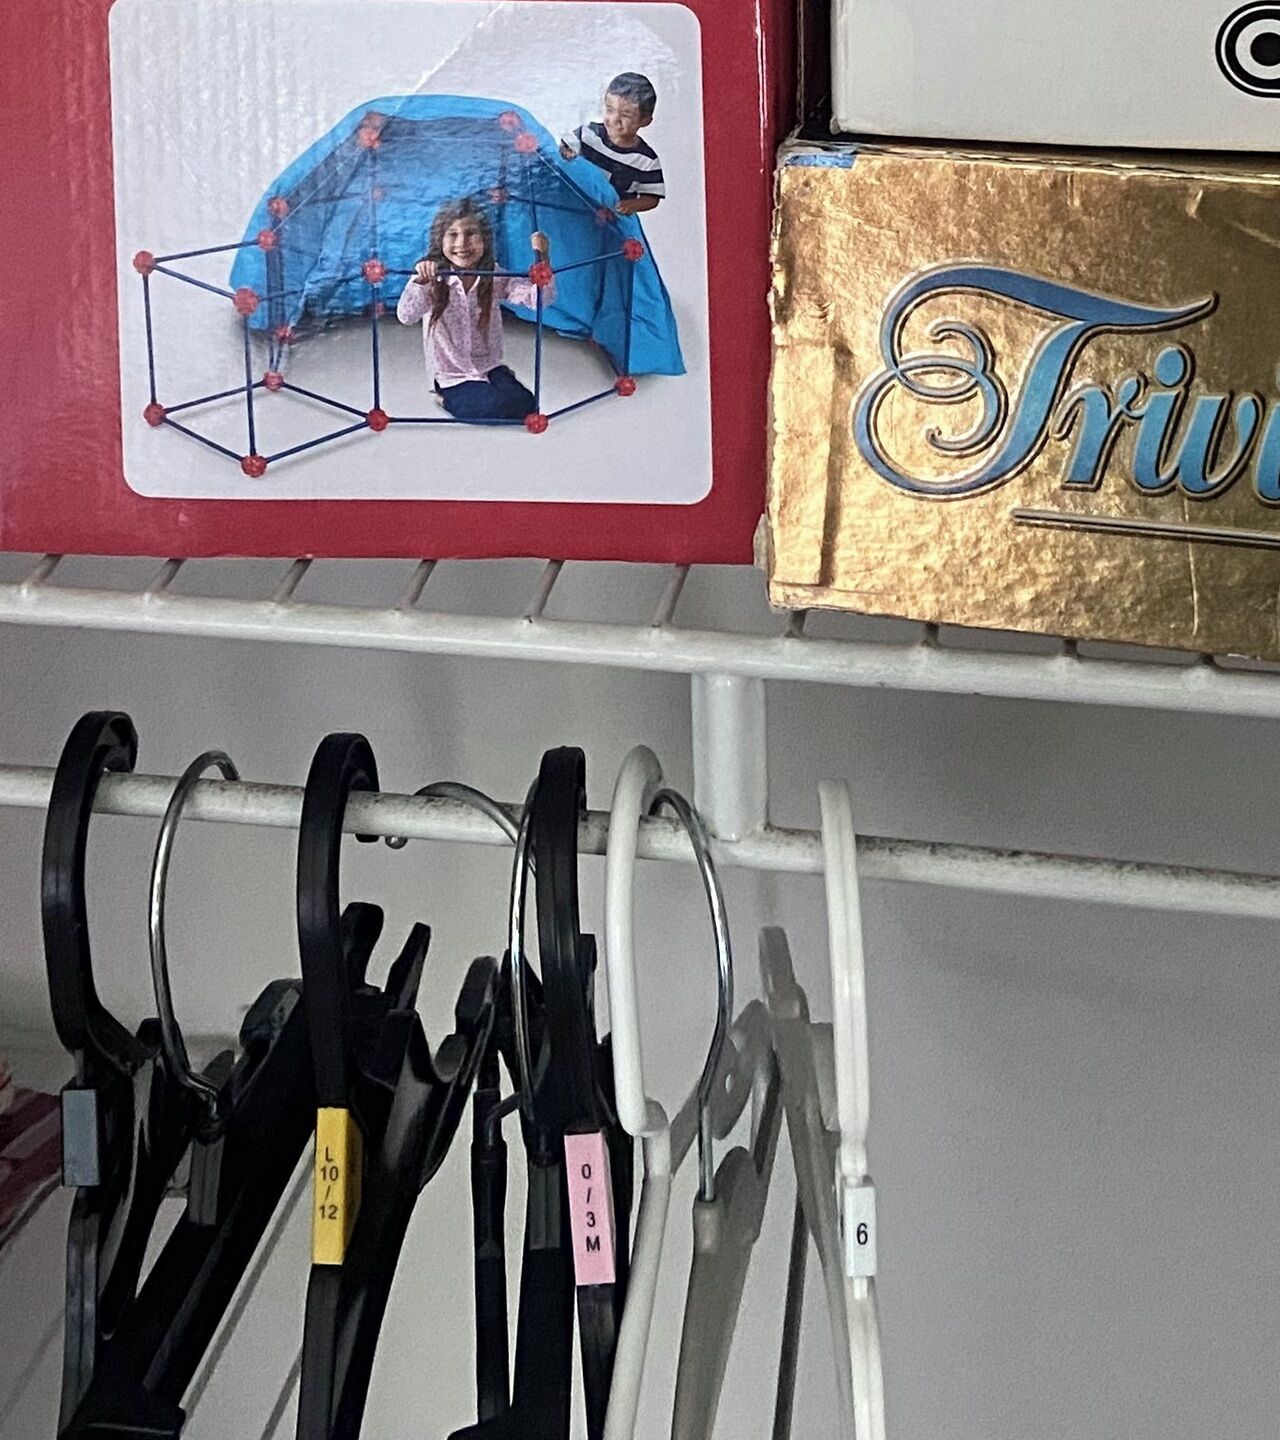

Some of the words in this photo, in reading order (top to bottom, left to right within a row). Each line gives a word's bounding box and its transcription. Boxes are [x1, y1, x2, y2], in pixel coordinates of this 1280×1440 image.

[324, 1147, 334, 1161] L
[320, 1166, 339, 1181] 10
[319, 1206, 337, 1220] 12
[586, 1212, 596, 1227] 3
[856, 1223, 868, 1245] 6
[586, 1236, 601, 1252] M
